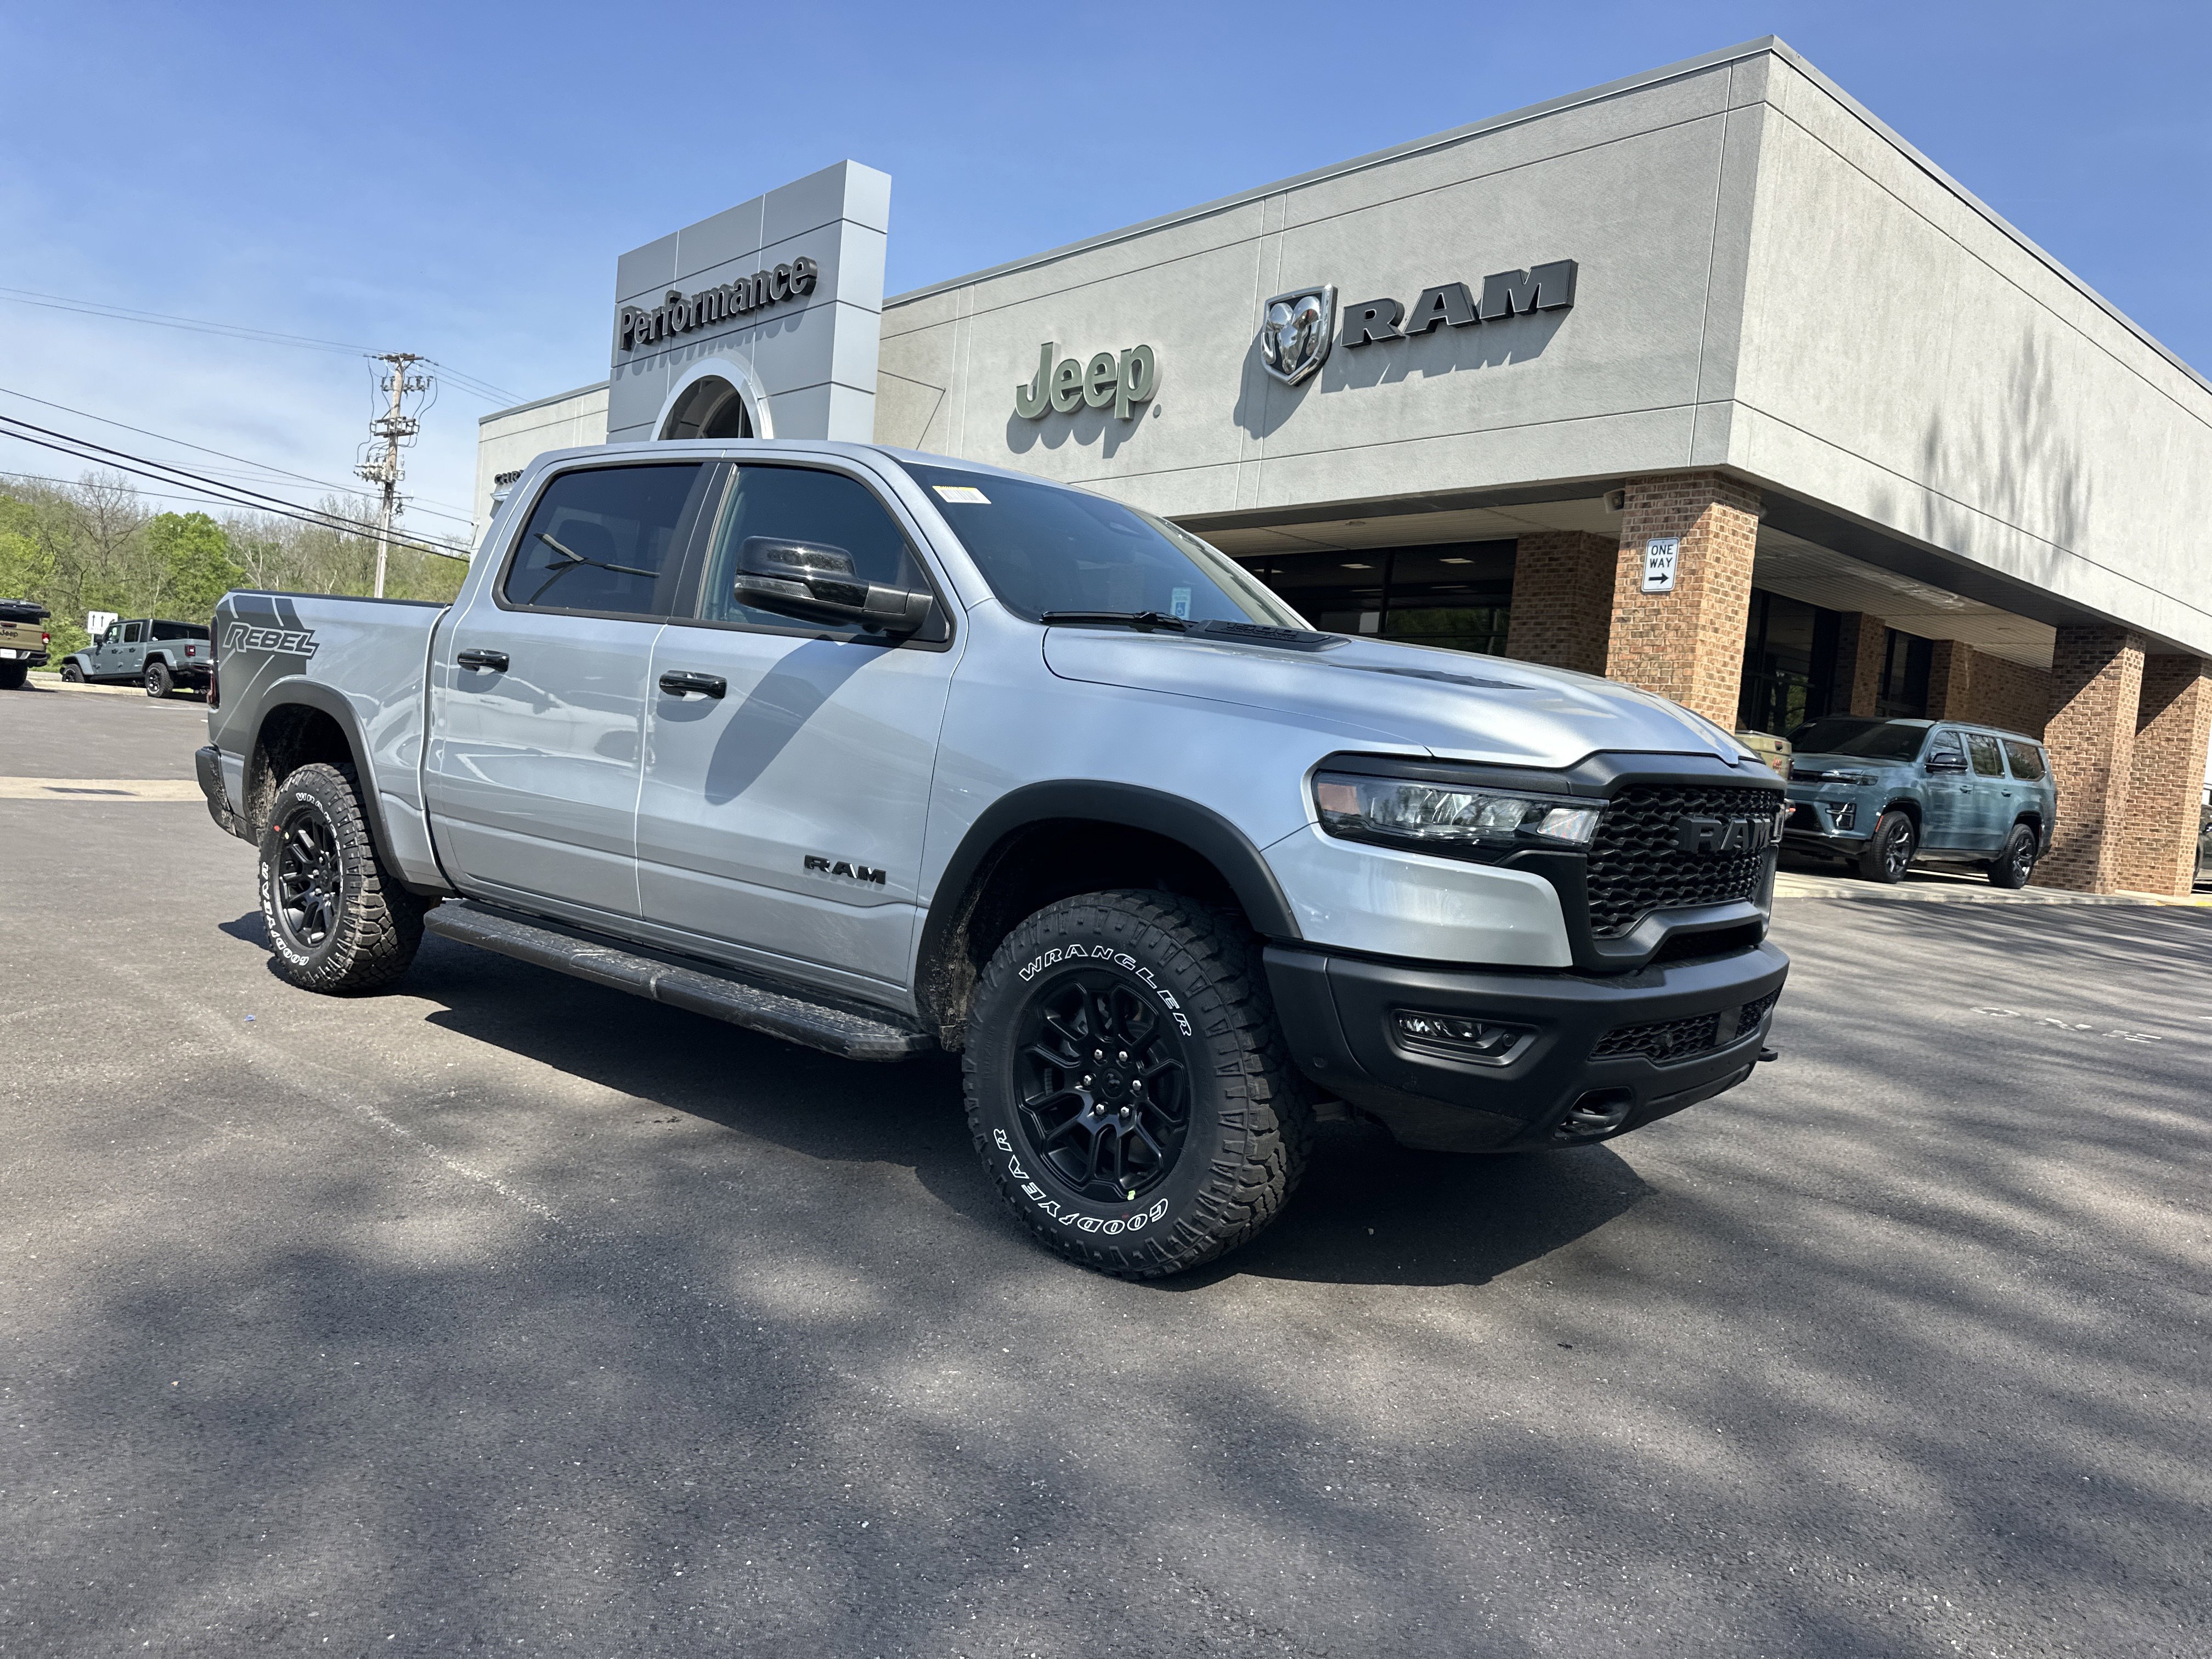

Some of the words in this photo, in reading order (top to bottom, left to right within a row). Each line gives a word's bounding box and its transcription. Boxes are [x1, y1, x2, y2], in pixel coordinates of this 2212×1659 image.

[619, 256, 817, 351] Performance
[1340, 259, 1578, 349] RAM
[1015, 341, 1161, 420] Jeep
[1650, 557, 1673, 568] WAY
[1651, 544, 1674, 555] ONE
[0, 630, 19, 638] Jeep
[223, 621, 317, 657] REBEL
[1677, 817, 1771, 854] RAM
[804, 854, 886, 885] RAM
[262, 861, 309, 966] GOODYEAR
[1018, 944, 1192, 1036] WRANGLER
[994, 1128, 1169, 1235] GOODYEAR
